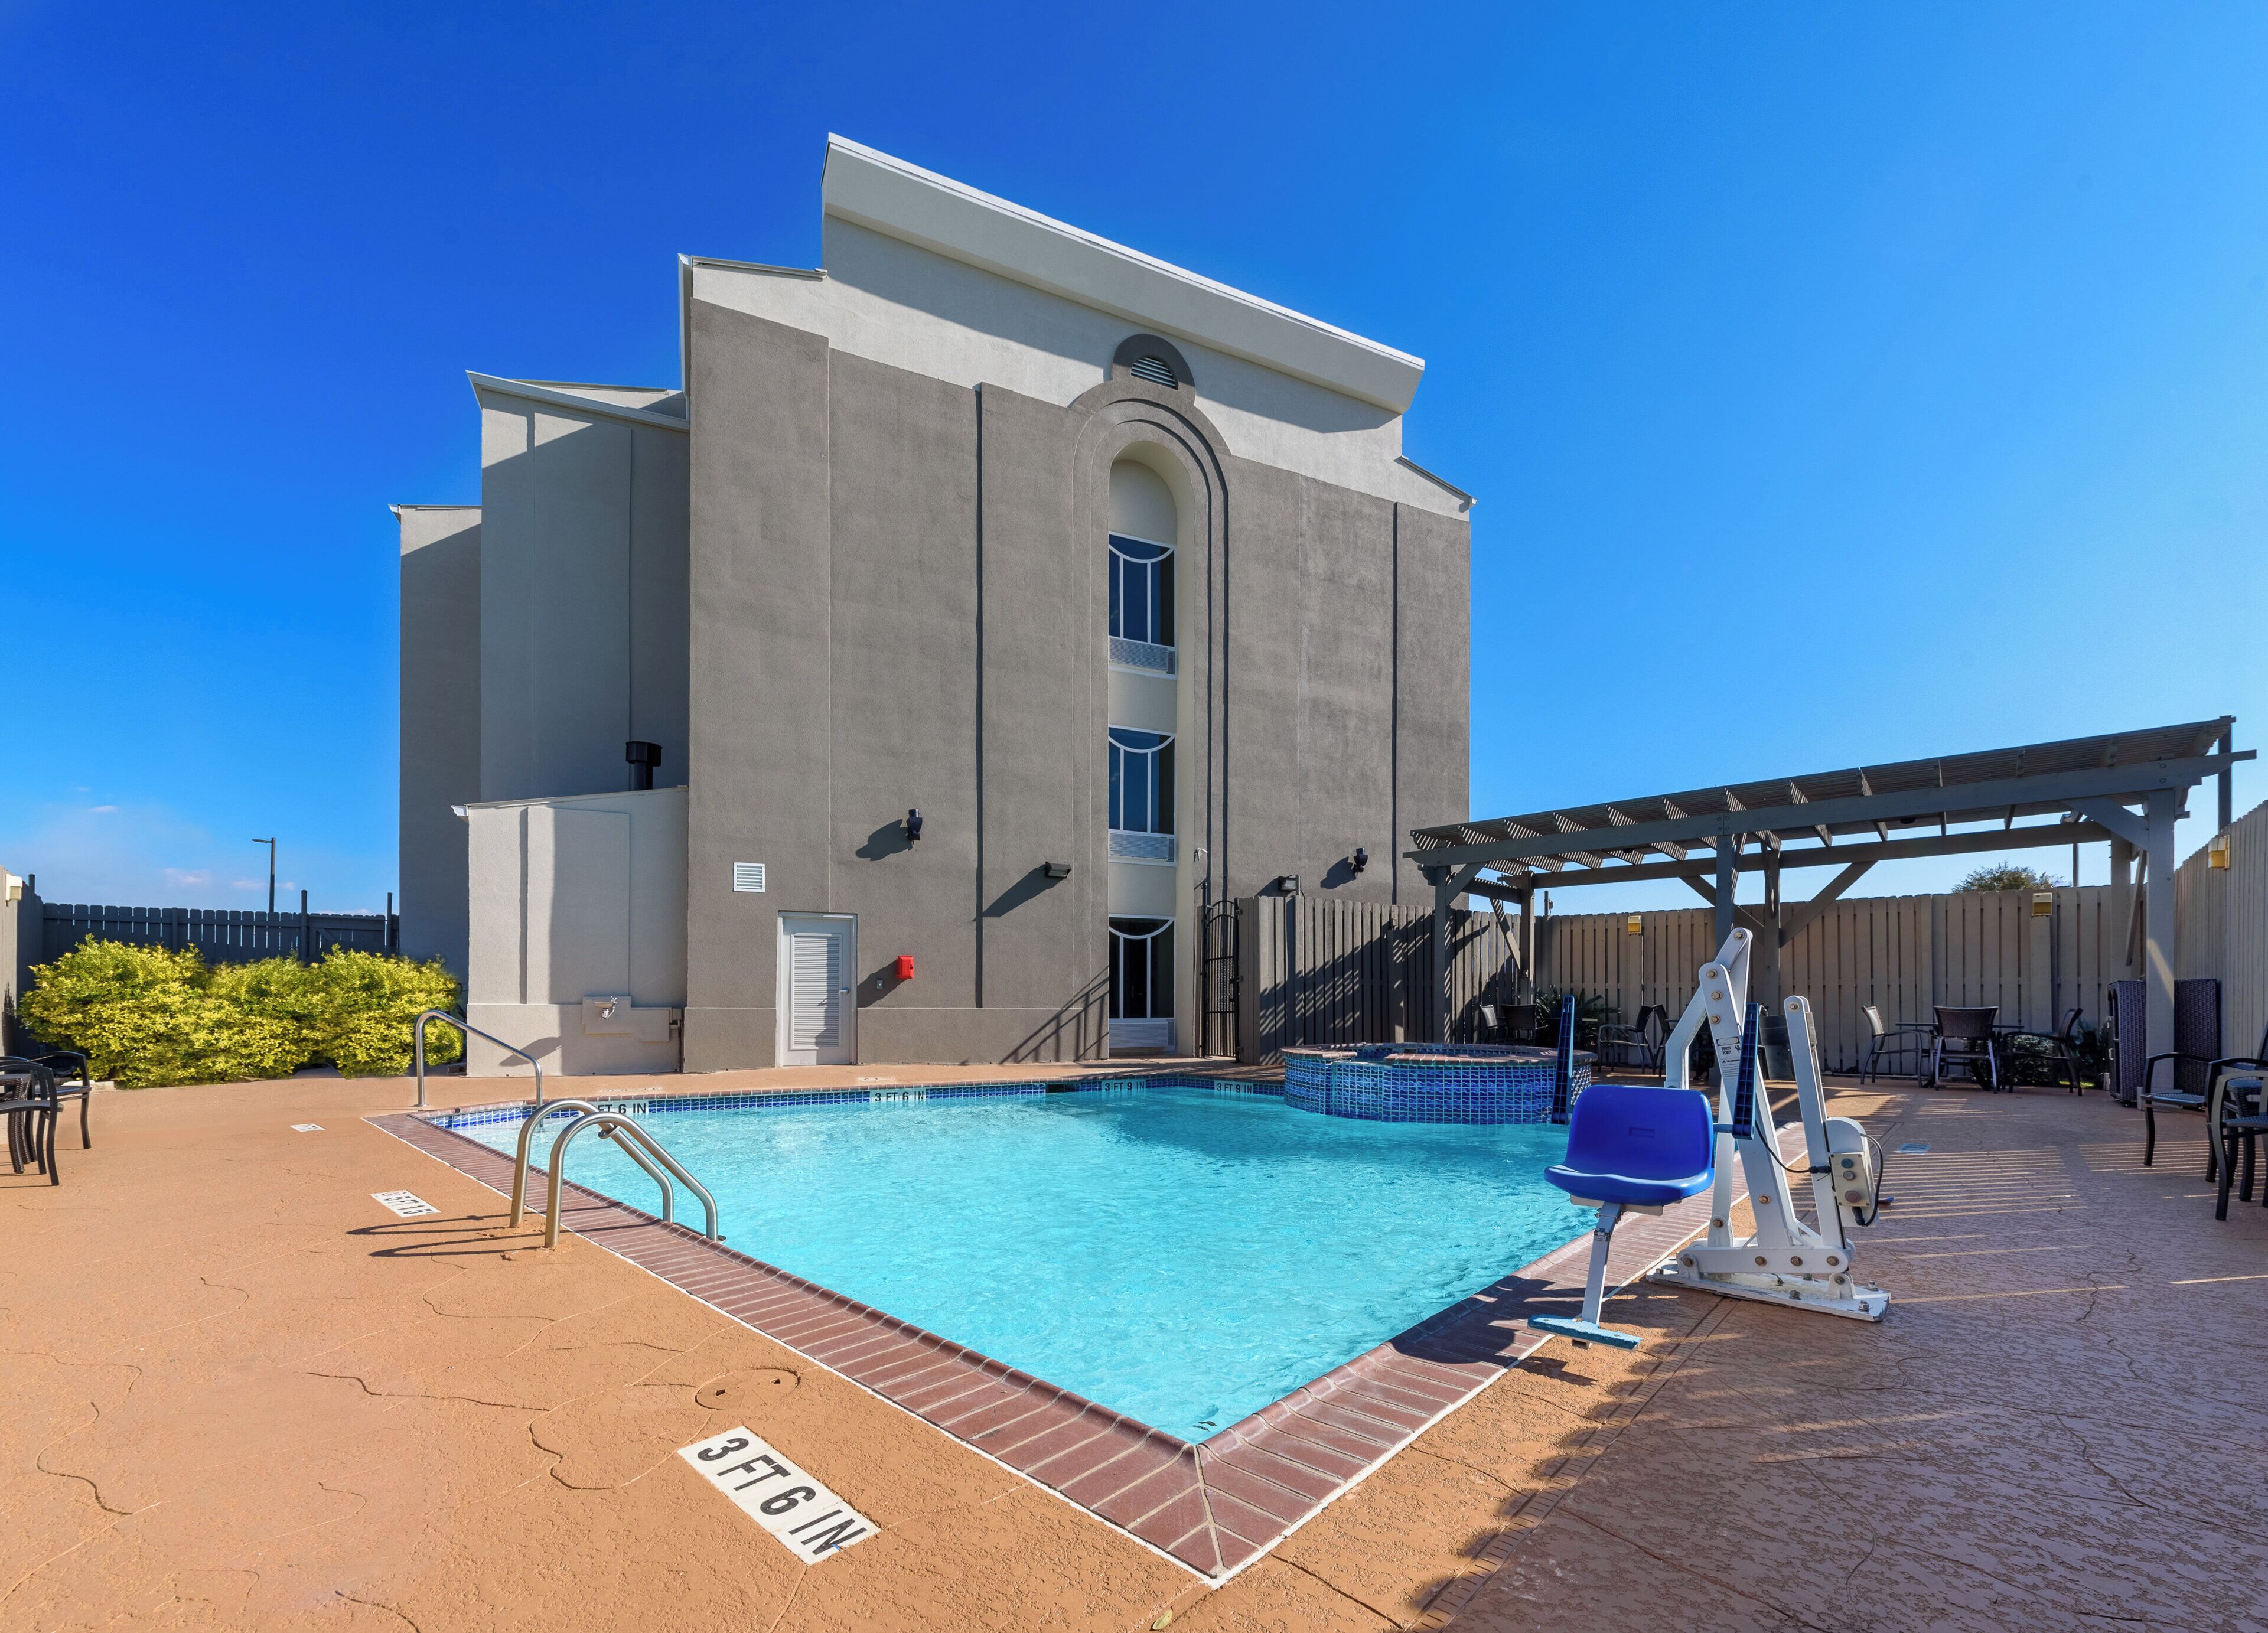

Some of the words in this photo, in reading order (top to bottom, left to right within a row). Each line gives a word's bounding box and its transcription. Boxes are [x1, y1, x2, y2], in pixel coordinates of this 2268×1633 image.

[1105, 1083, 1110, 1091] 3
[1114, 1082, 1123, 1090] FT
[1127, 1081, 1132, 1090] 9
[1136, 1081, 1145, 1090] IN
[1217, 1083, 1222, 1091] 3
[1224, 1083, 1233, 1091] FT
[1236, 1084, 1241, 1093] 9
[1244, 1084, 1252, 1093] IN
[875, 1093, 881, 1101] 3
[886, 1092, 898, 1101] FT
[902, 1091, 909, 1100] 6
[914, 1091, 924, 1100] IN
[618, 1104, 627, 1114] 6
[633, 1103, 646, 1114] IN
[697, 1438, 750, 1461] 3
[716, 1454, 792, 1491] FT
[760, 1486, 817, 1515] 6
[788, 1509, 868, 1556] IN
